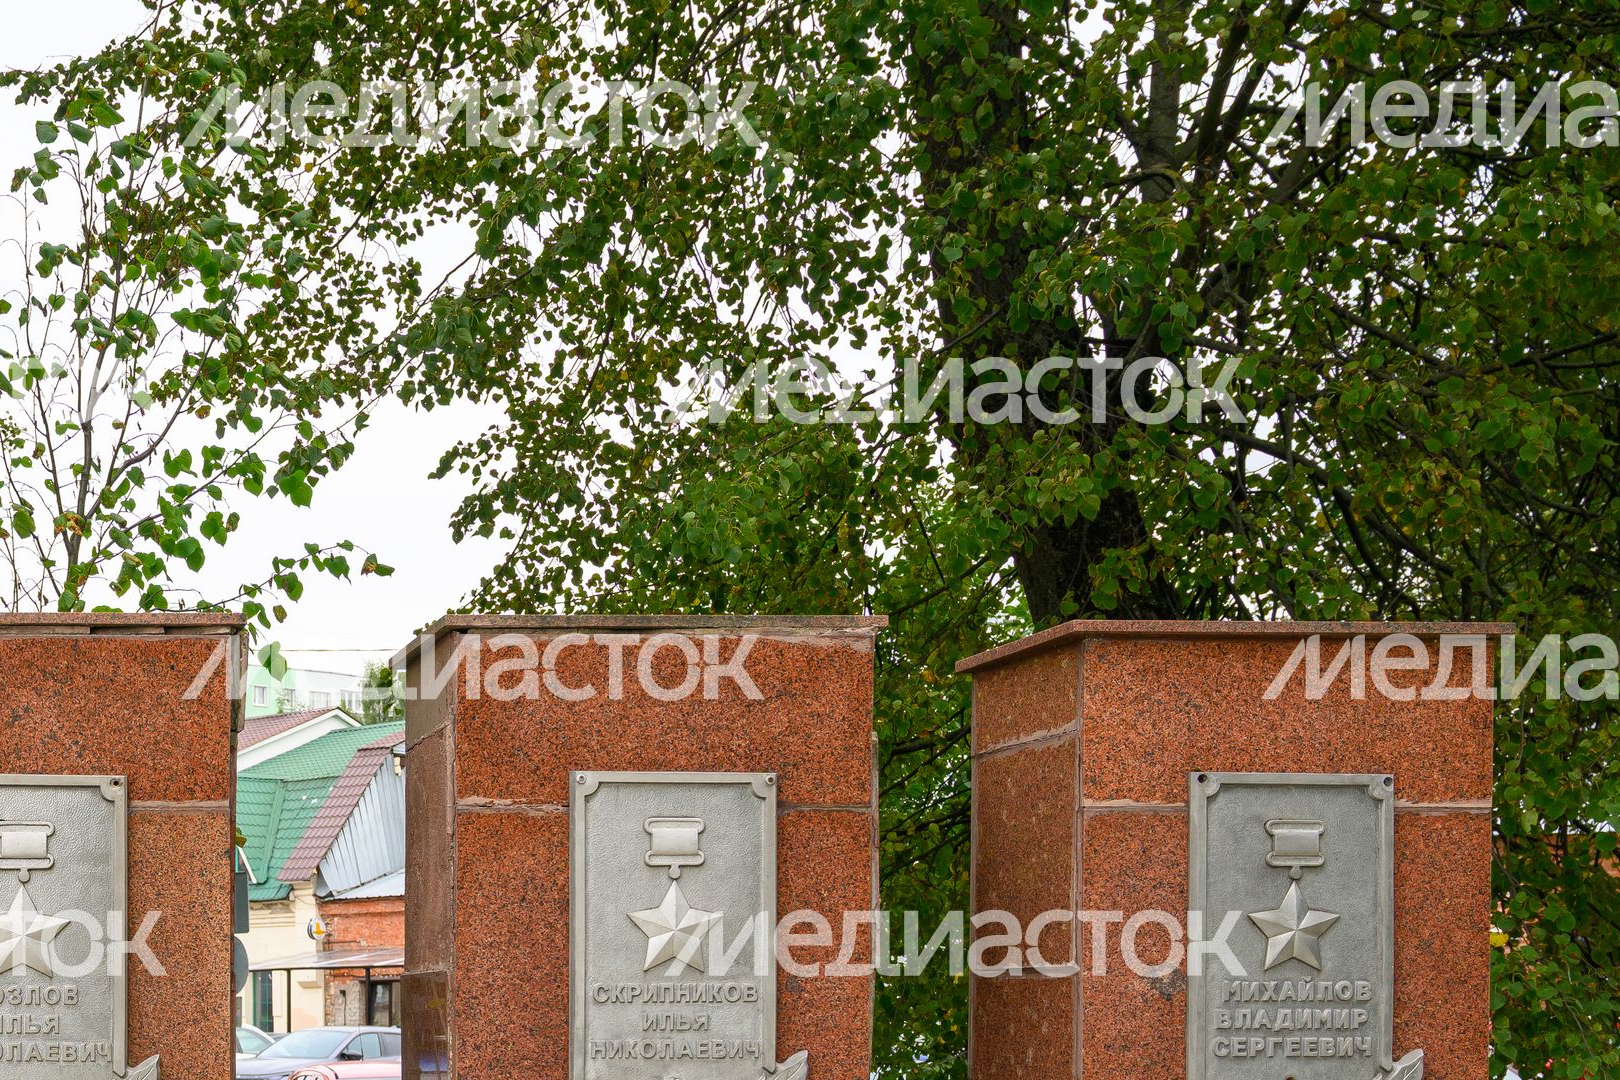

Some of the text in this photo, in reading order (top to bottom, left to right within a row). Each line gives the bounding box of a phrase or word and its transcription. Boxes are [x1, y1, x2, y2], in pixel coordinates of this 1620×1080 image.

[592, 982, 759, 1004] СКРИПНИКОВ
[1221, 976, 1373, 1003] МИХАЙЛОВ
[641, 1012, 711, 1032] ИЛЬЯ
[1213, 1008, 1369, 1032] ВЛАДИМИР
[589, 1039, 760, 1060] НИКОЛАЕВИЧ
[1211, 1036, 1373, 1059] СЕРГЕЕВИЧ
